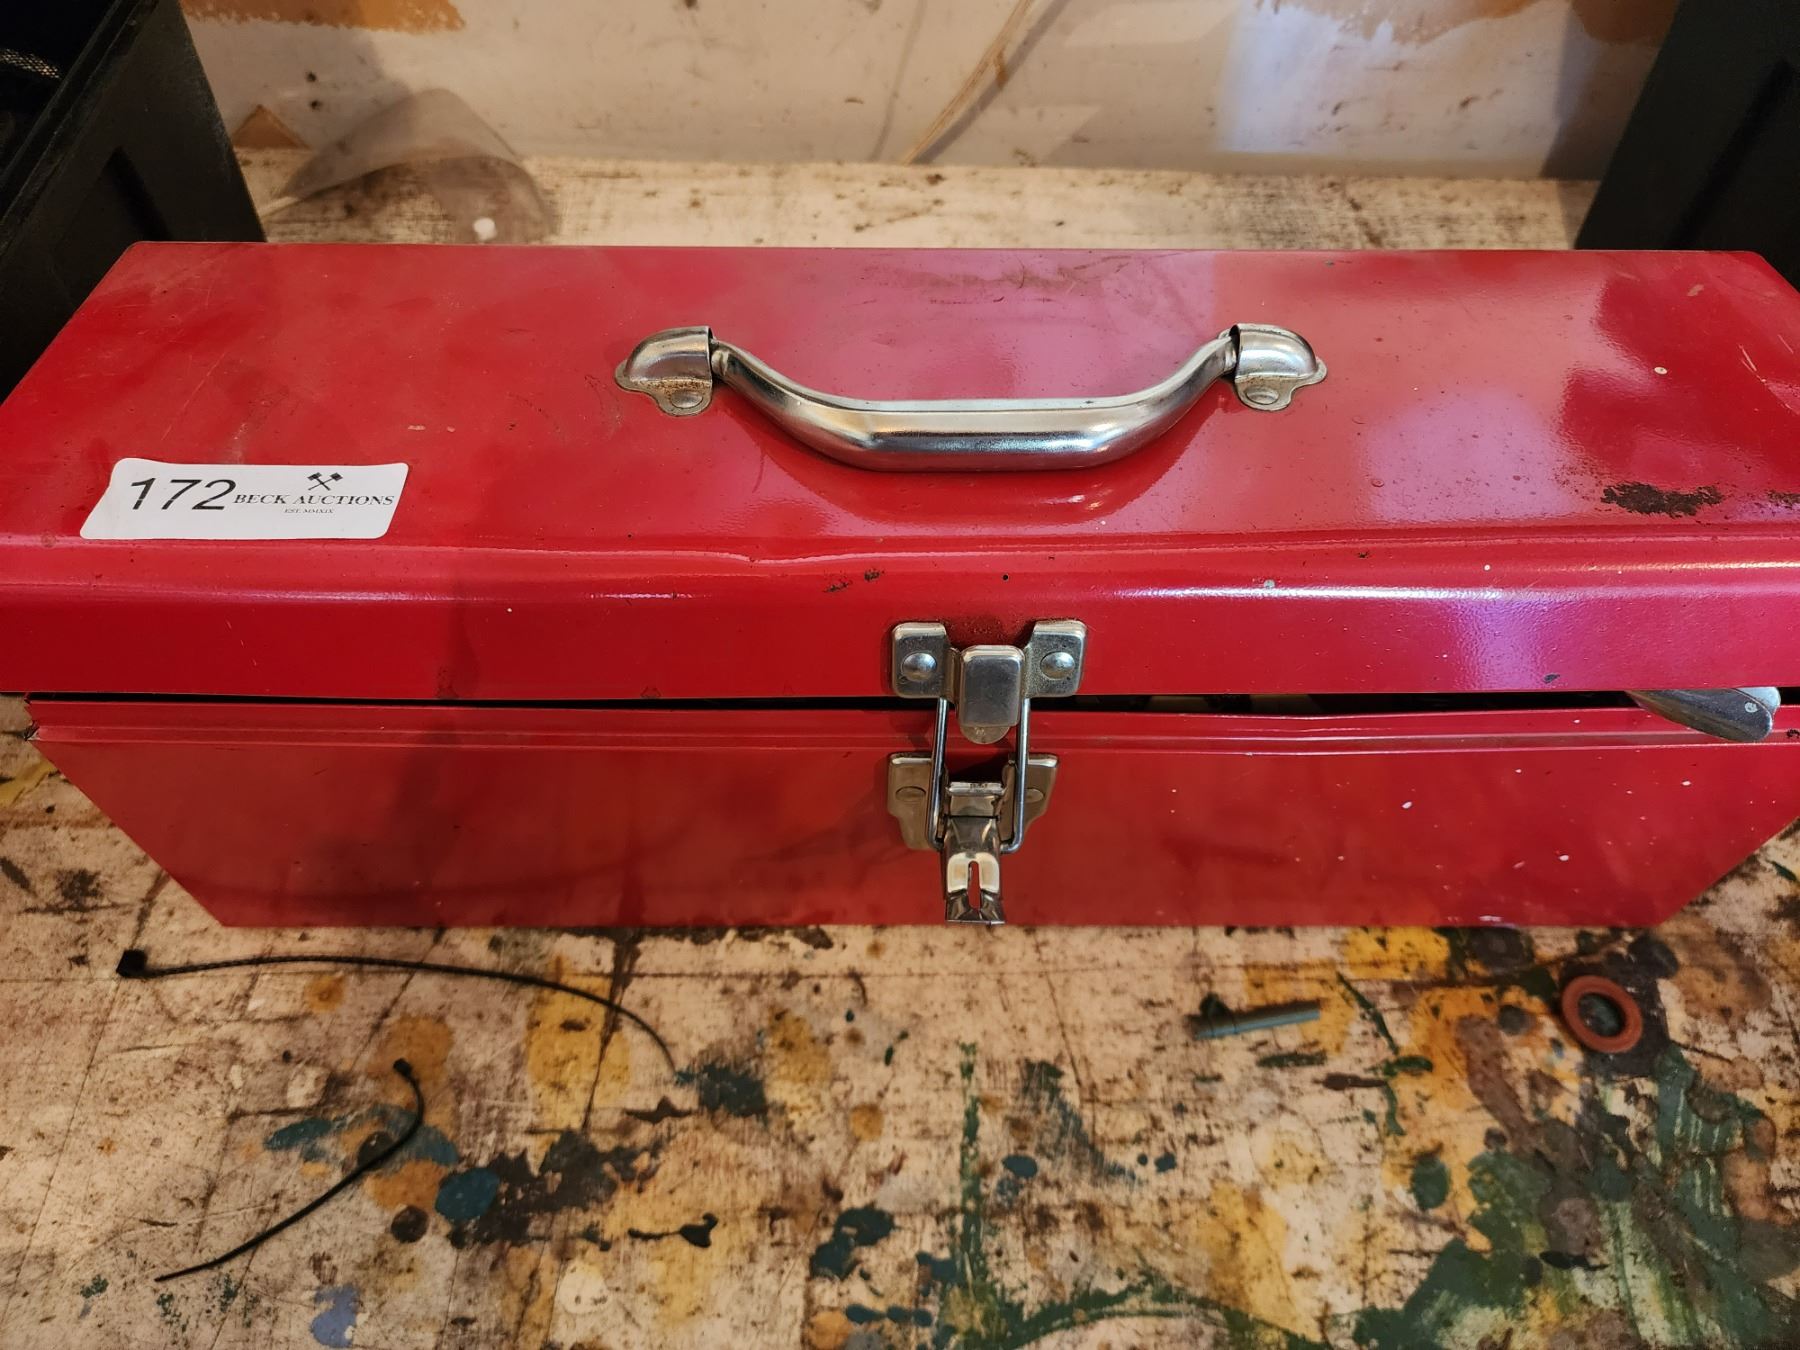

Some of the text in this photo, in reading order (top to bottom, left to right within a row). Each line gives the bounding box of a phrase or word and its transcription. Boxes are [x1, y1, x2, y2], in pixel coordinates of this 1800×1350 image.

[131, 477, 237, 511] 172
[233, 494, 395, 506] BECK AUCTIONS
